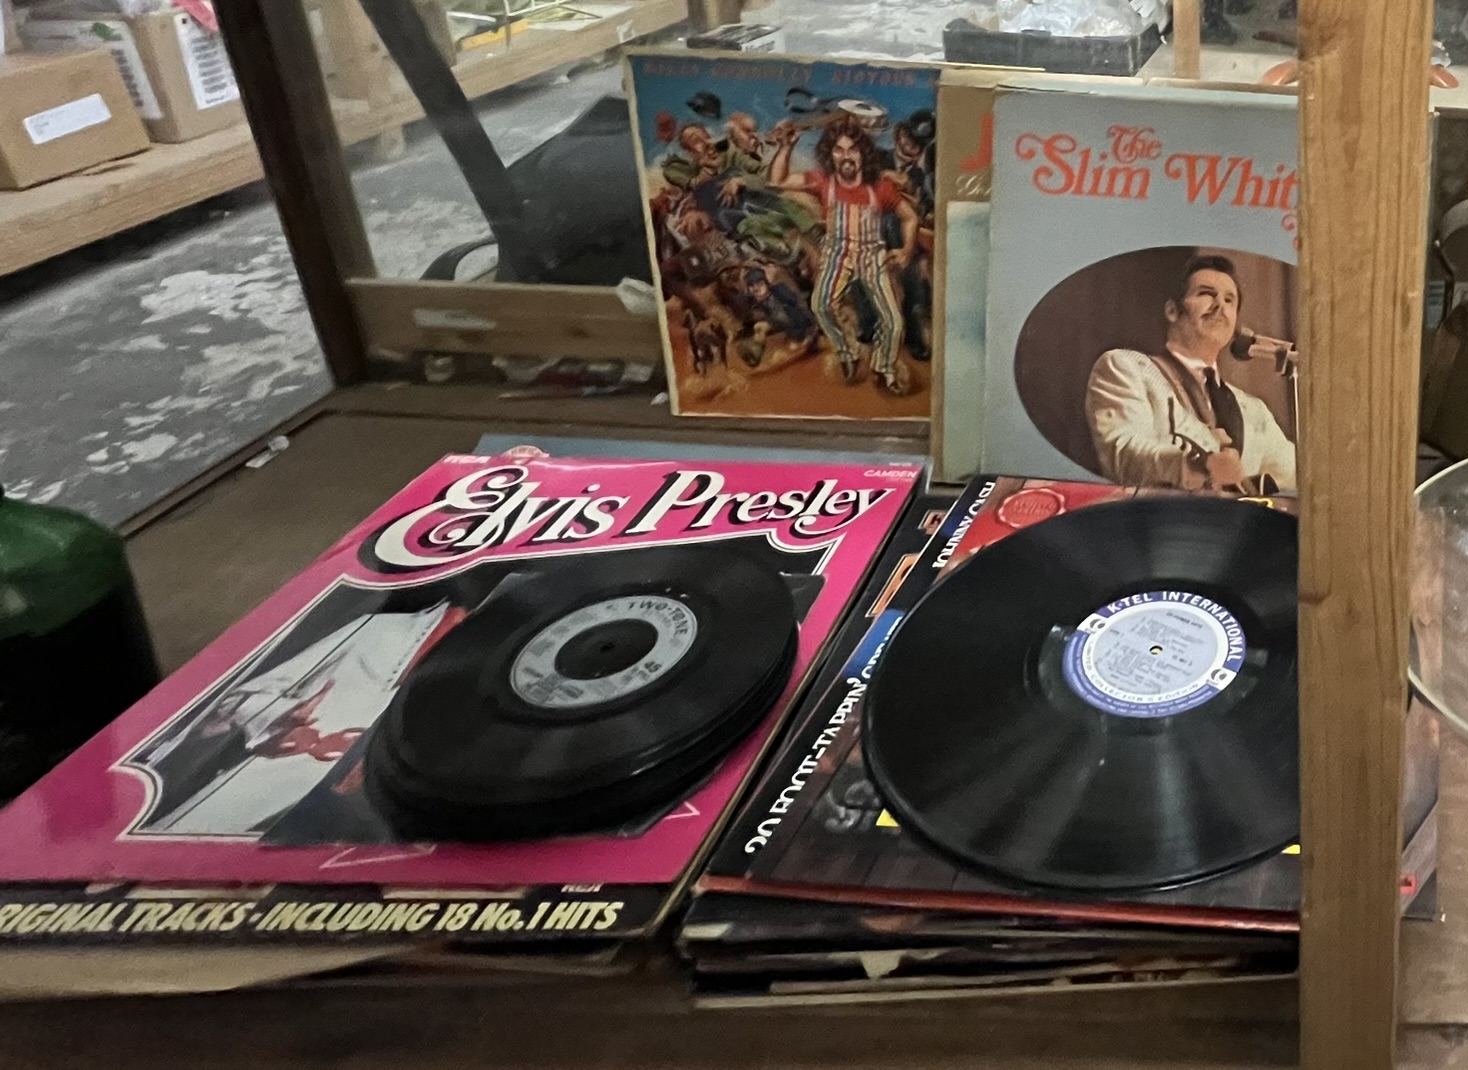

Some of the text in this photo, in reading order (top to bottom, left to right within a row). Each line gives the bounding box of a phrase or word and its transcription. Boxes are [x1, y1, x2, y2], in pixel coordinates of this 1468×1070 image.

[1015, 133, 1152, 199] Slim
[1107, 124, 1162, 163] The
[863, 469, 918, 479] CAMDEN
[373, 465, 896, 568] Elvis Presley
[1162, 590, 1243, 662] INTERNATIONAL
[432, 901, 479, 932] 18
[541, 901, 625, 931] HITS
